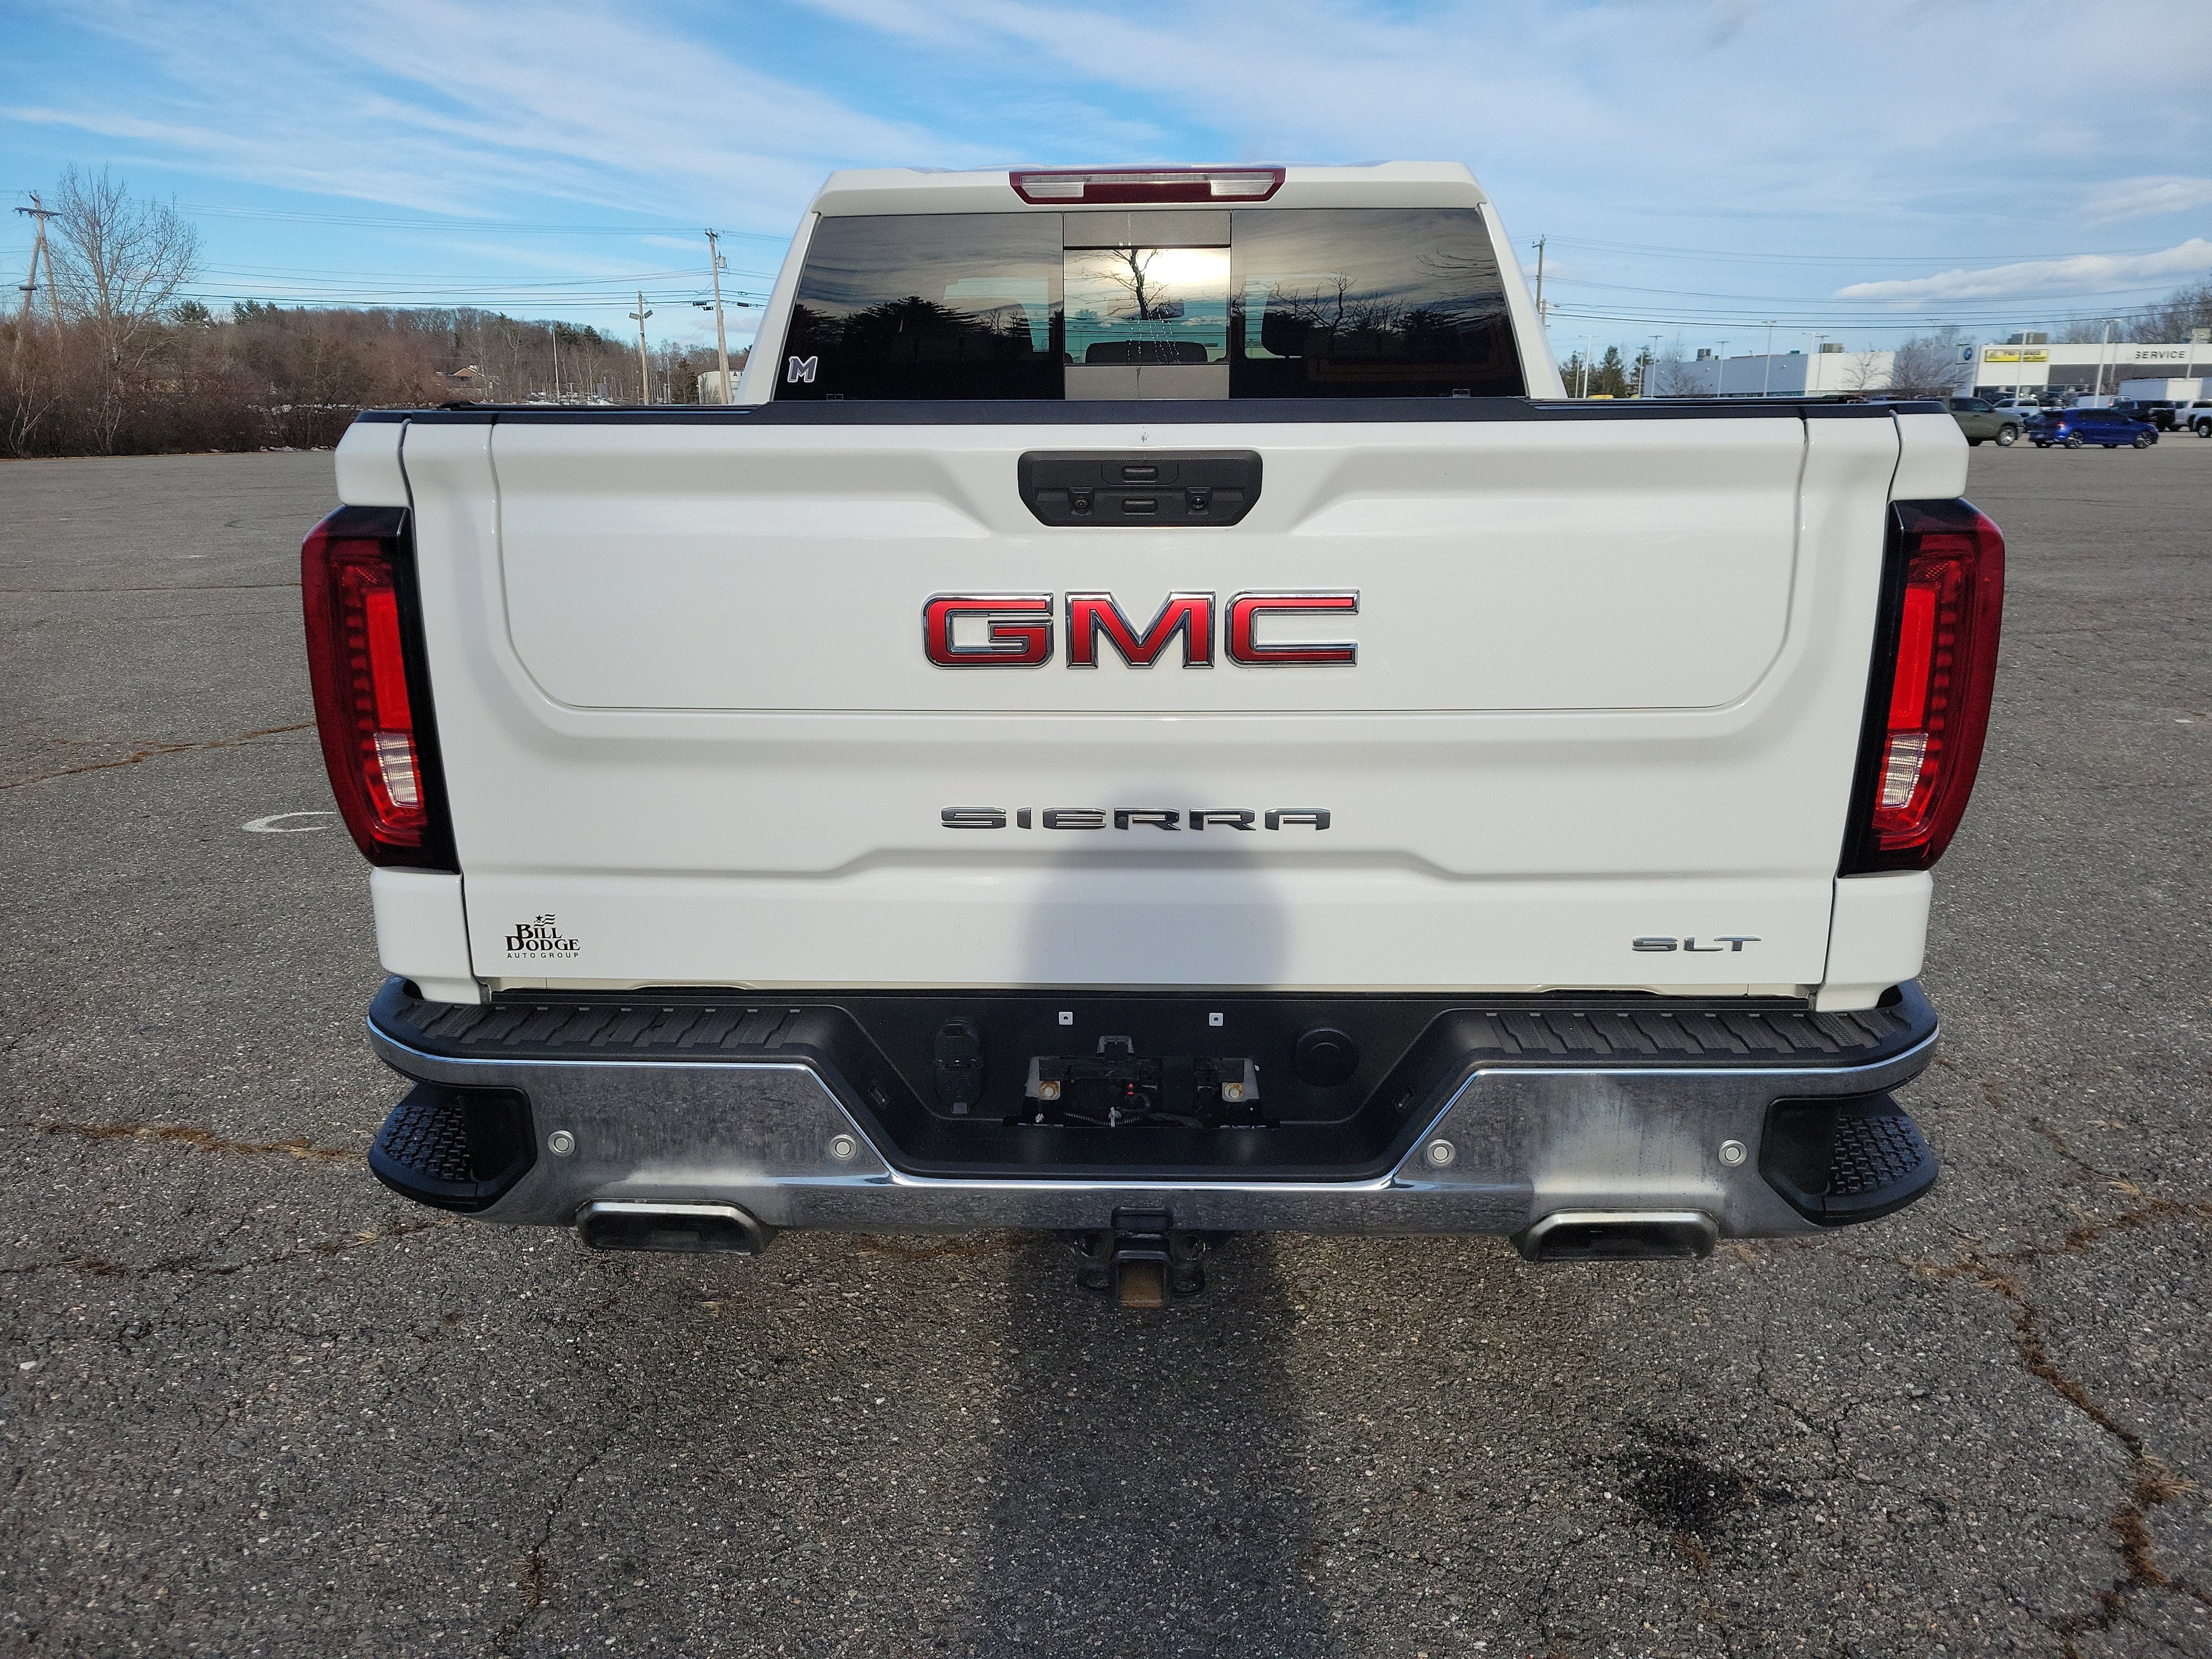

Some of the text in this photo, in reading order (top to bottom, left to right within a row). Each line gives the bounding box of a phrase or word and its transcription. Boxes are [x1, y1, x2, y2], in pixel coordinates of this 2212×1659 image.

[787, 356, 817, 382] M
[923, 589, 1360, 670] GMC
[941, 806, 1331, 832] SIERRA
[515, 924, 562, 939] BILL
[504, 935, 580, 951] DODGE
[1632, 936, 1762, 952] SLT
